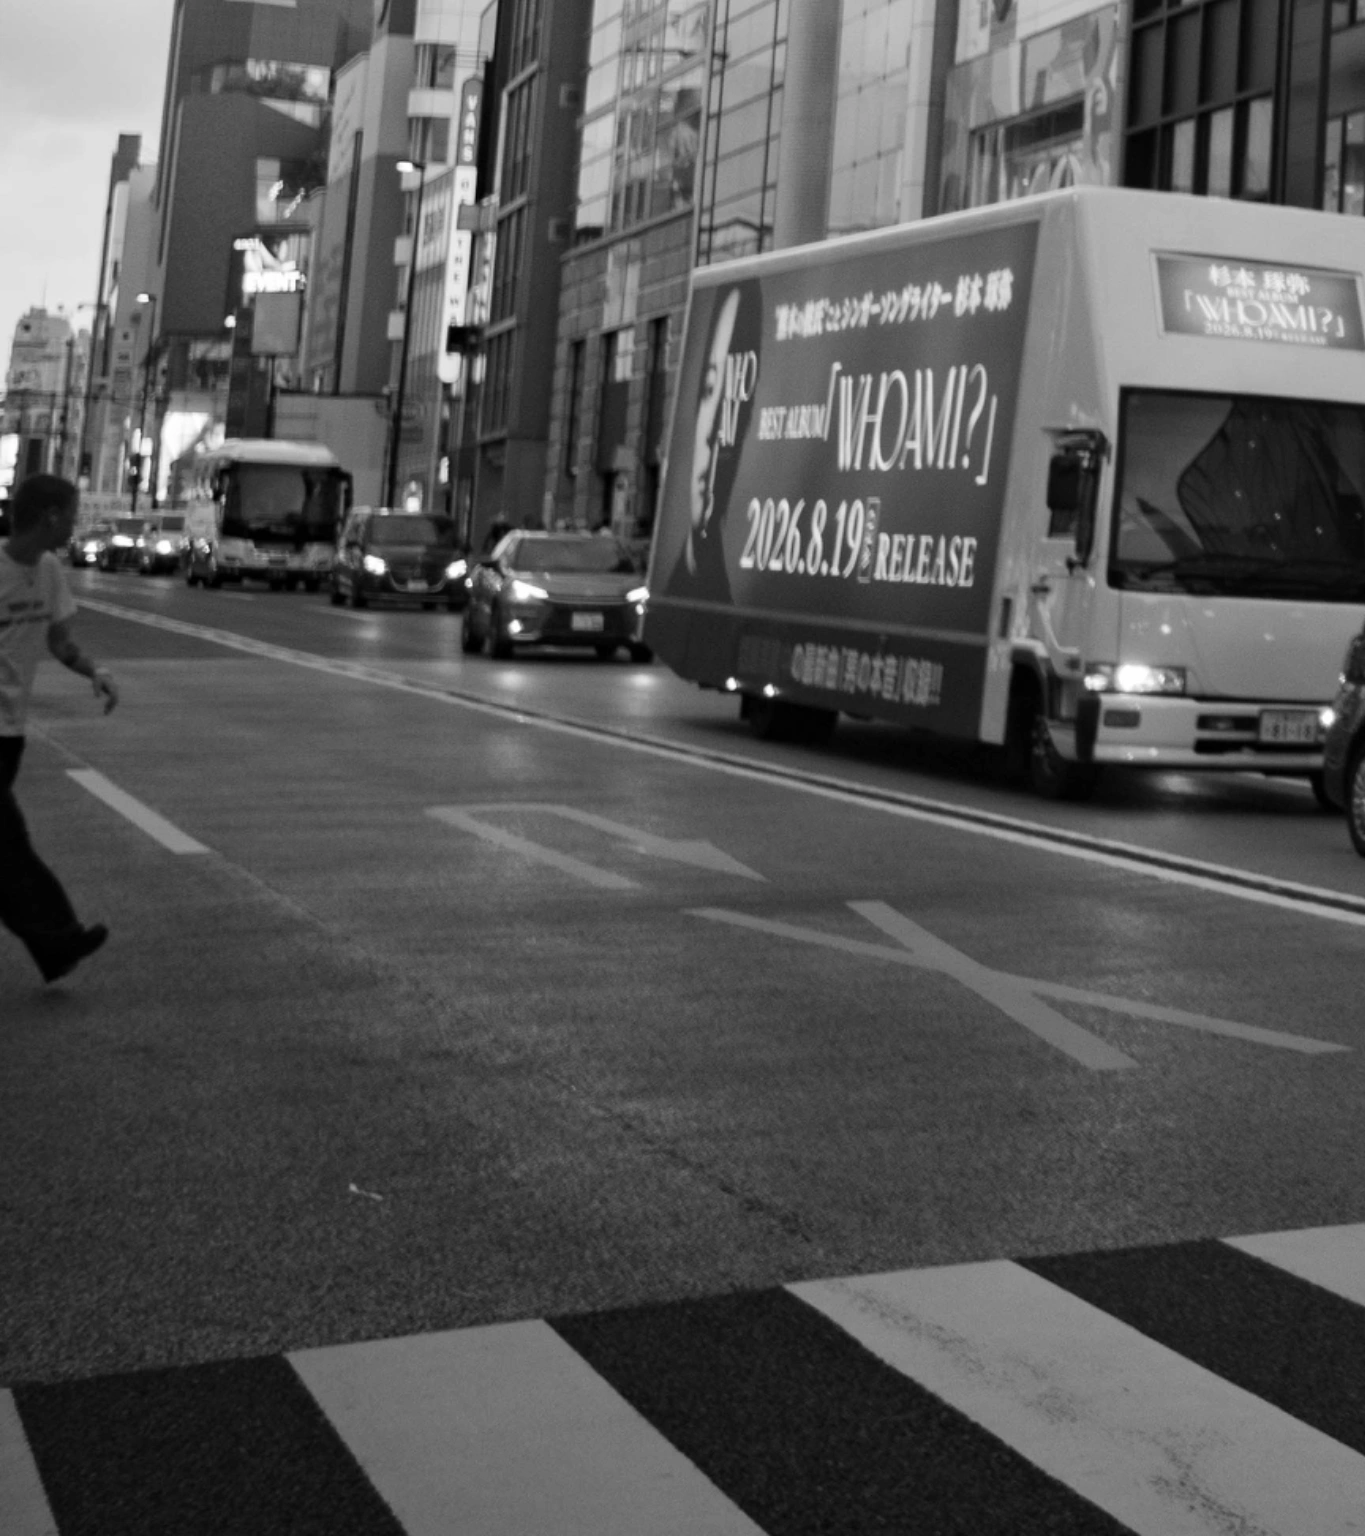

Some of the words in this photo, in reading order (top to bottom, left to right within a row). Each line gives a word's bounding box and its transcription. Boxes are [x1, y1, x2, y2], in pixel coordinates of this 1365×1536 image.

[462, 94, 479, 162] VANS
[758, 405, 787, 441] BEST
[739, 497, 865, 579] 2026.8.19
[874, 532, 978, 588] RELEASE
